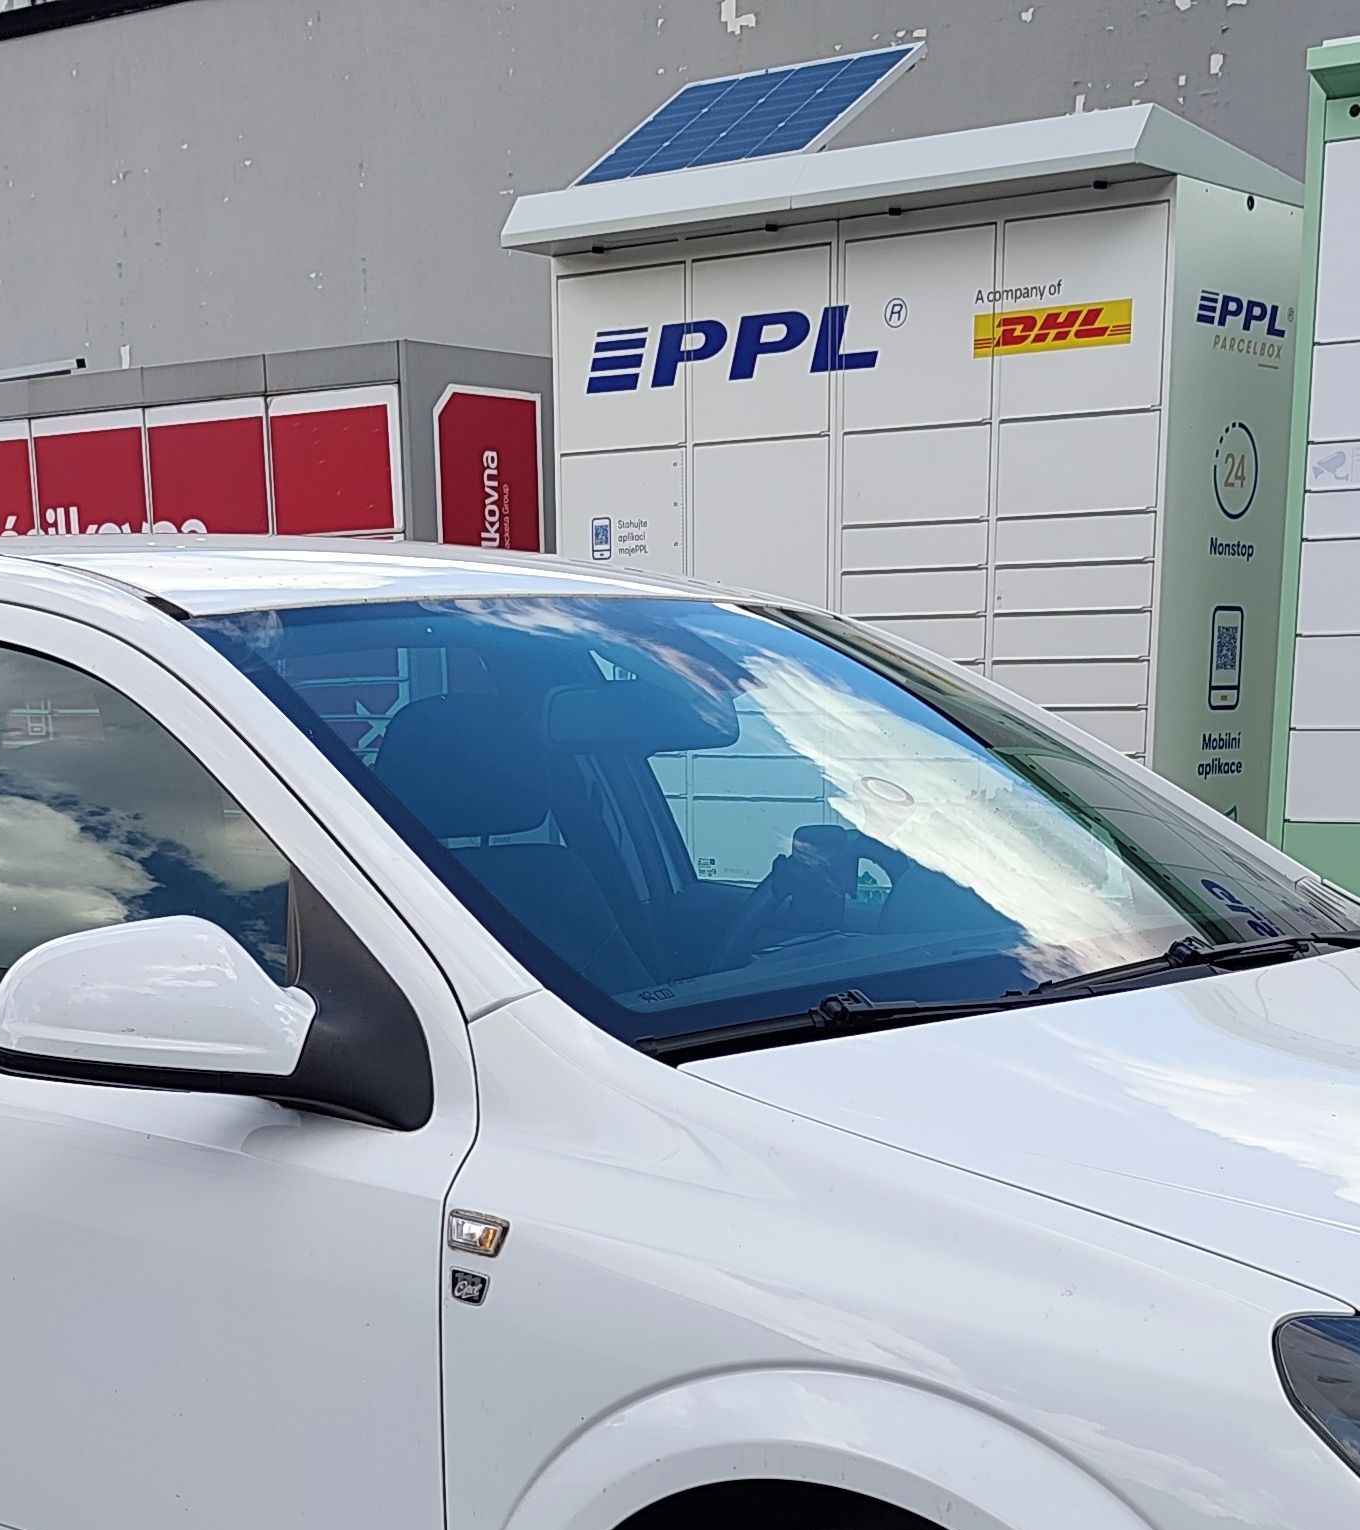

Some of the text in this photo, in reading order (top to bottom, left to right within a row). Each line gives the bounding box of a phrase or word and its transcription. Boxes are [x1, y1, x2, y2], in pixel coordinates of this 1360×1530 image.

[975, 279, 1063, 304] A company of
[993, 307, 1111, 348] DHL
[1212, 334, 1283, 360] PARCELBOX
[1223, 452, 1247, 489] 24
[617, 519, 648, 531] Stahujte
[1209, 537, 1255, 562] Nonstop
[1201, 731, 1243, 751] Mobilní
[1197, 757, 1243, 781] aplikace
